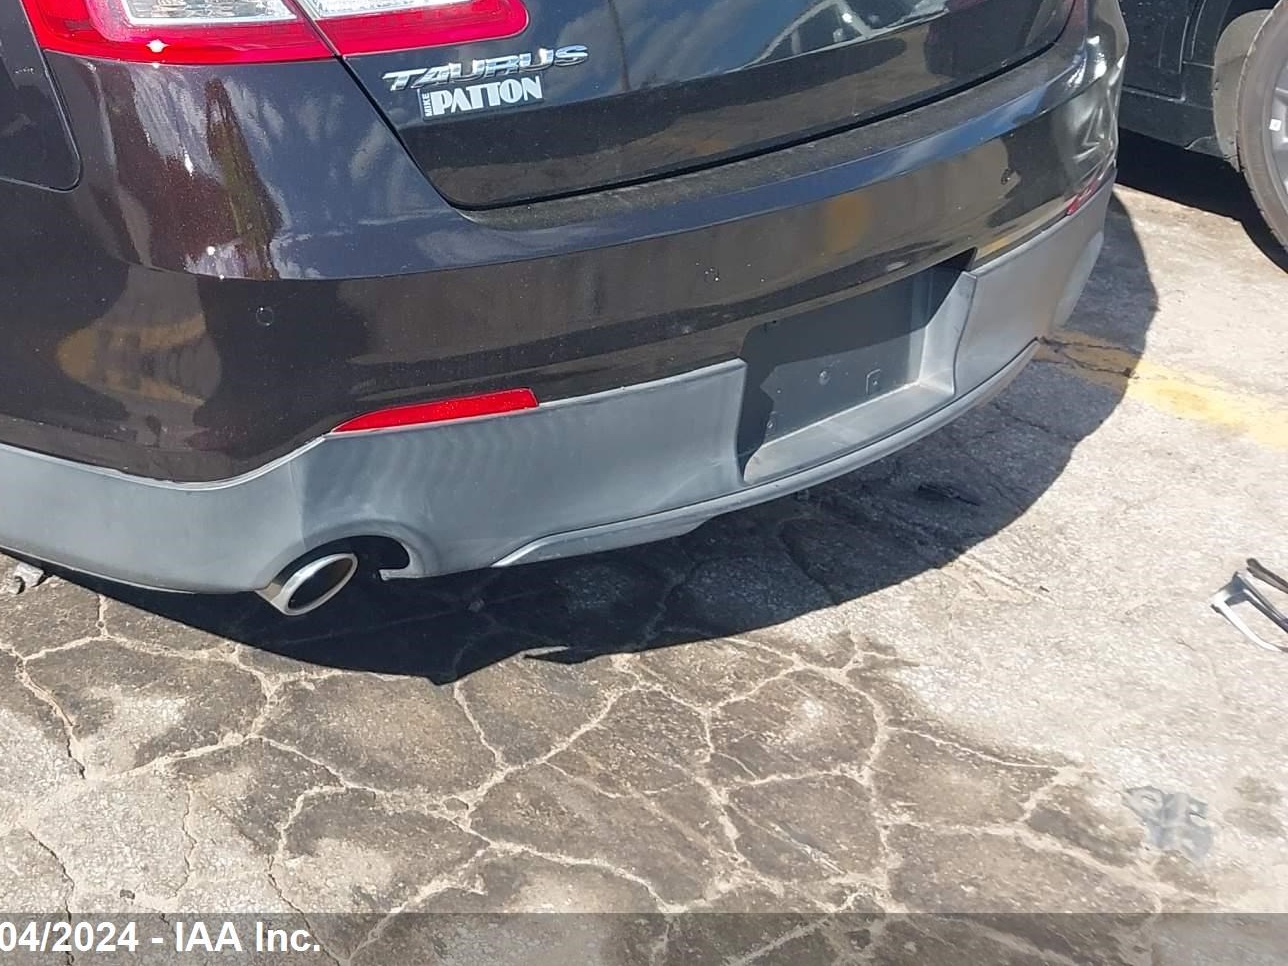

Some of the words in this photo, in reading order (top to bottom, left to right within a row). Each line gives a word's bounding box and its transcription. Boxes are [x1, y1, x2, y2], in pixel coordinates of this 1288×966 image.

[382, 45, 589, 91] TAURUS
[423, 93, 433, 117] MIKE
[430, 75, 543, 117] PATTON
